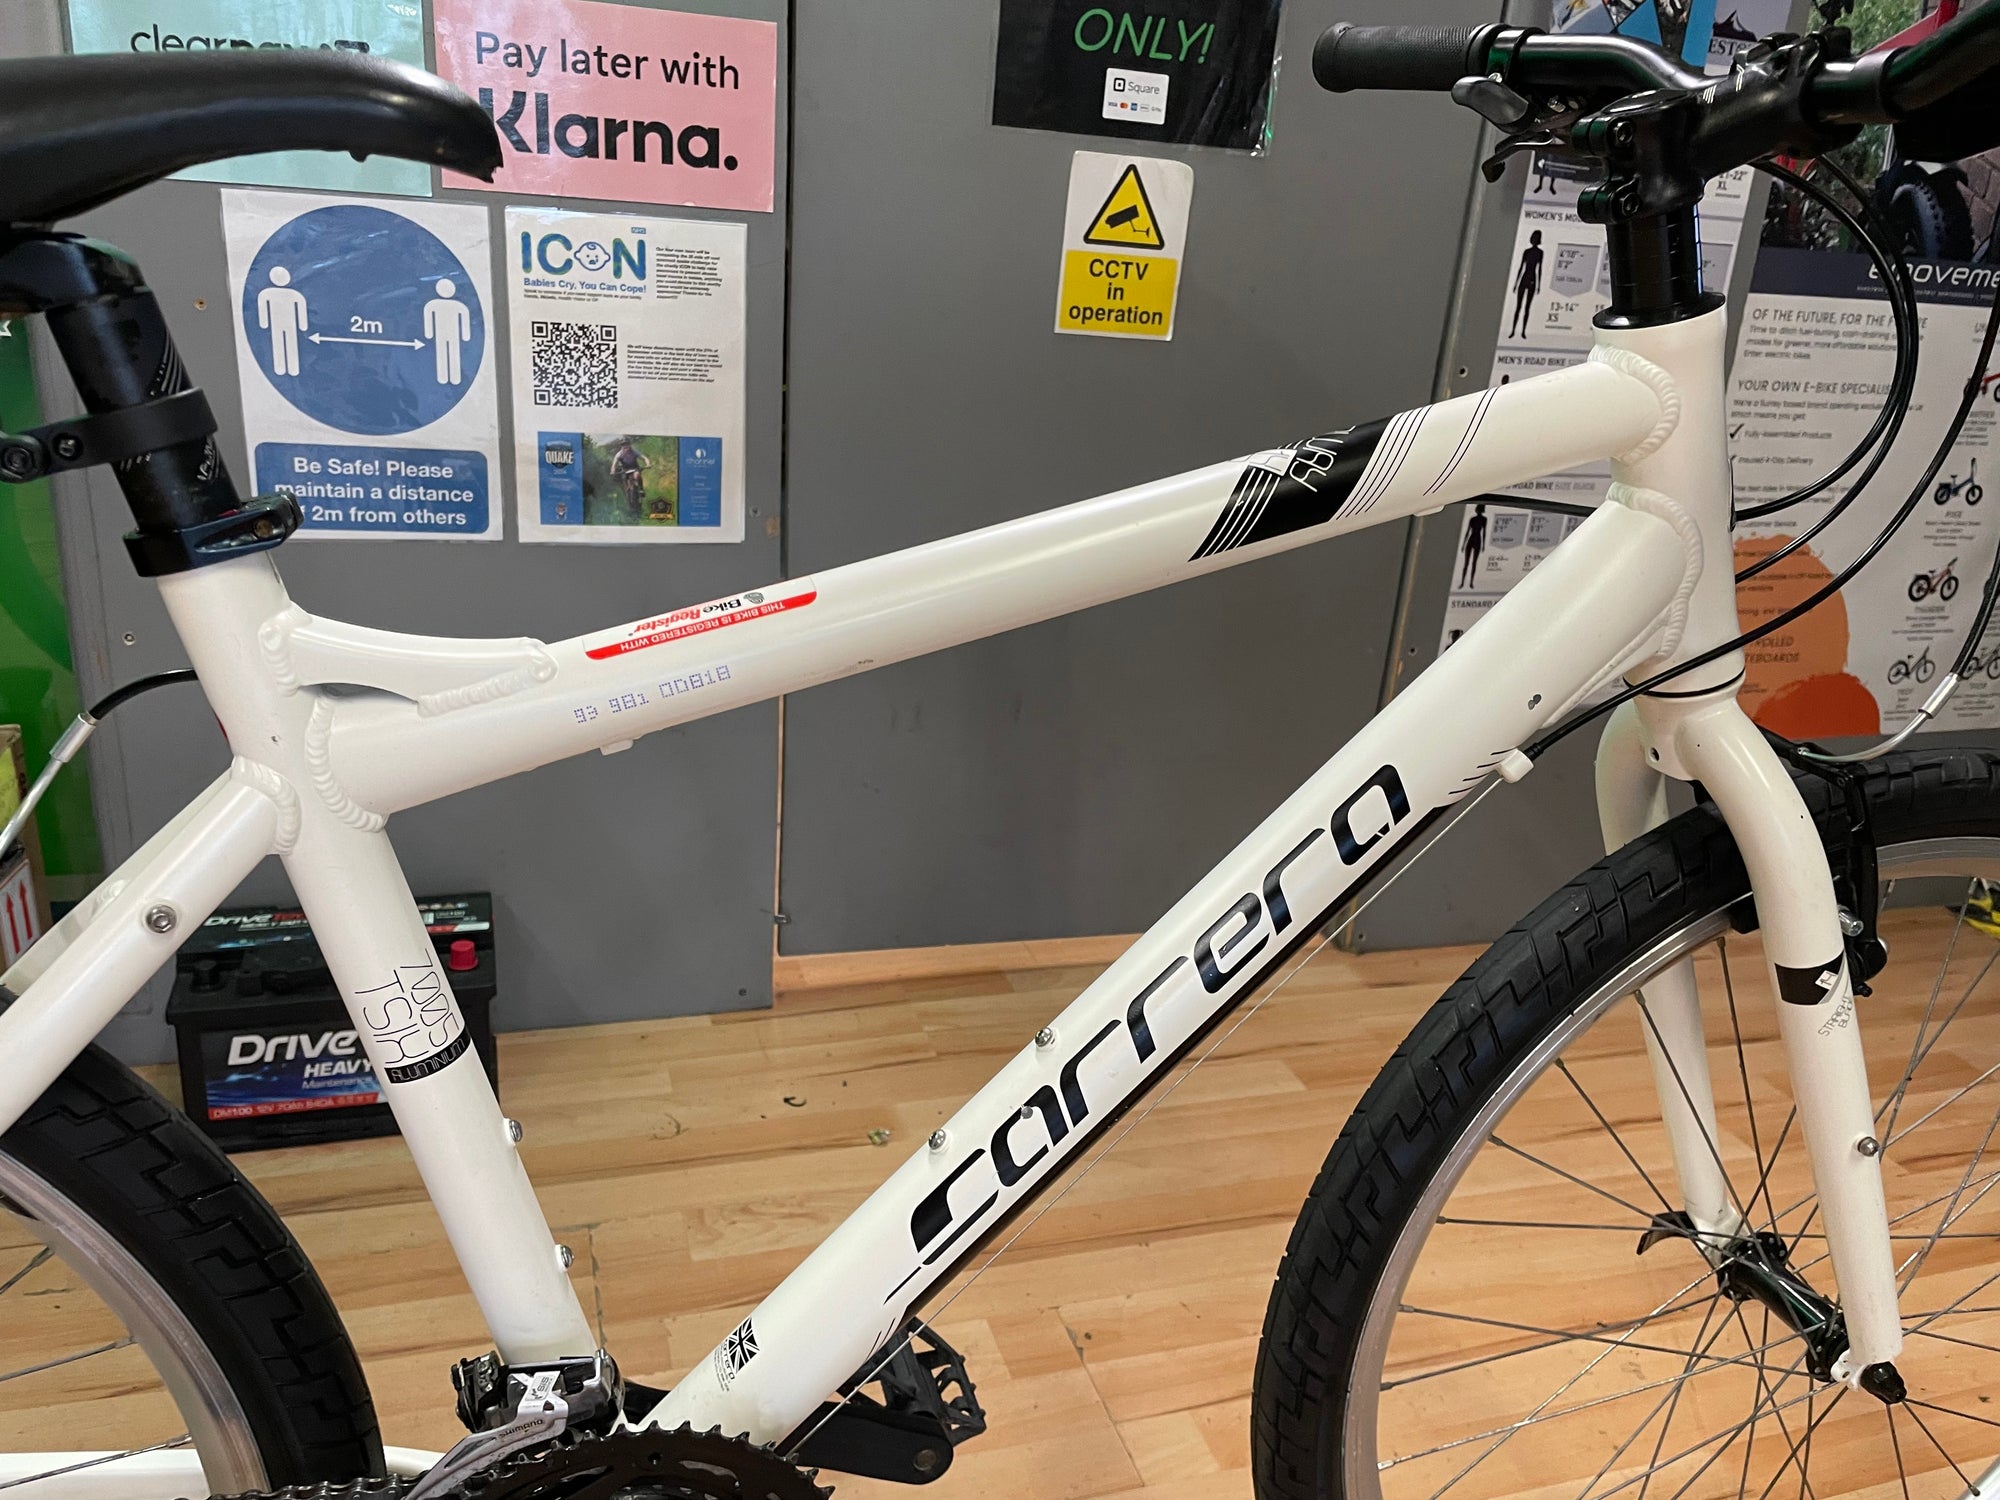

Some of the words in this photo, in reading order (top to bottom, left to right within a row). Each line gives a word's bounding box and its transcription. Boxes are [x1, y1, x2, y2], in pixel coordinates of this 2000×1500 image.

[1074, 8, 1215, 64] ONLY!
[476, 31, 547, 78] Pay
[560, 39, 648, 79] later
[661, 52, 739, 89] with
[1128, 81, 1160, 94] Square
[1089, 258, 1149, 280] CCTV
[524, 278, 556, 288] Babies
[558, 280, 577, 290] Cry,
[580, 281, 596, 290] You
[599, 283, 617, 291] Can
[620, 284, 646, 294] Cope!
[1107, 282, 1124, 301] in
[350, 316, 383, 333] 2m
[1069, 305, 1163, 326] operation
[1752, 309, 1768, 320] OF
[1773, 310, 1793, 321] THE
[1840, 313, 1861, 325] FOR
[1866, 315, 1884, 326] THE
[1524, 357, 1545, 365] ROAD
[1738, 380, 1768, 392] YOUR
[1771, 380, 1800, 392] OWN
[1803, 381, 1838, 393] E-BIKE
[545, 451, 574, 464] QUAKE
[294, 458, 321, 474] Be
[327, 459, 380, 476] Safe!
[386, 461, 453, 478] Please
[370, 488, 382, 500] a
[389, 485, 473, 503] distance
[312, 505, 343, 522] 2m
[349, 507, 397, 523] from
[403, 509, 466, 526] others
[735, 609, 759, 622] BIKE
[761, 601, 786, 616] THIS
[722, 616, 732, 624] IS
[651, 618, 720, 644] REGISTERED
[620, 638, 650, 651] WITH
[574, 705, 598, 724] 93
[608, 693, 649, 713] 981
[910, 763, 1411, 1265] carrera
[304, 1058, 372, 1078] HEAVY
[391, 1038, 466, 1082] ALUMINIUM
